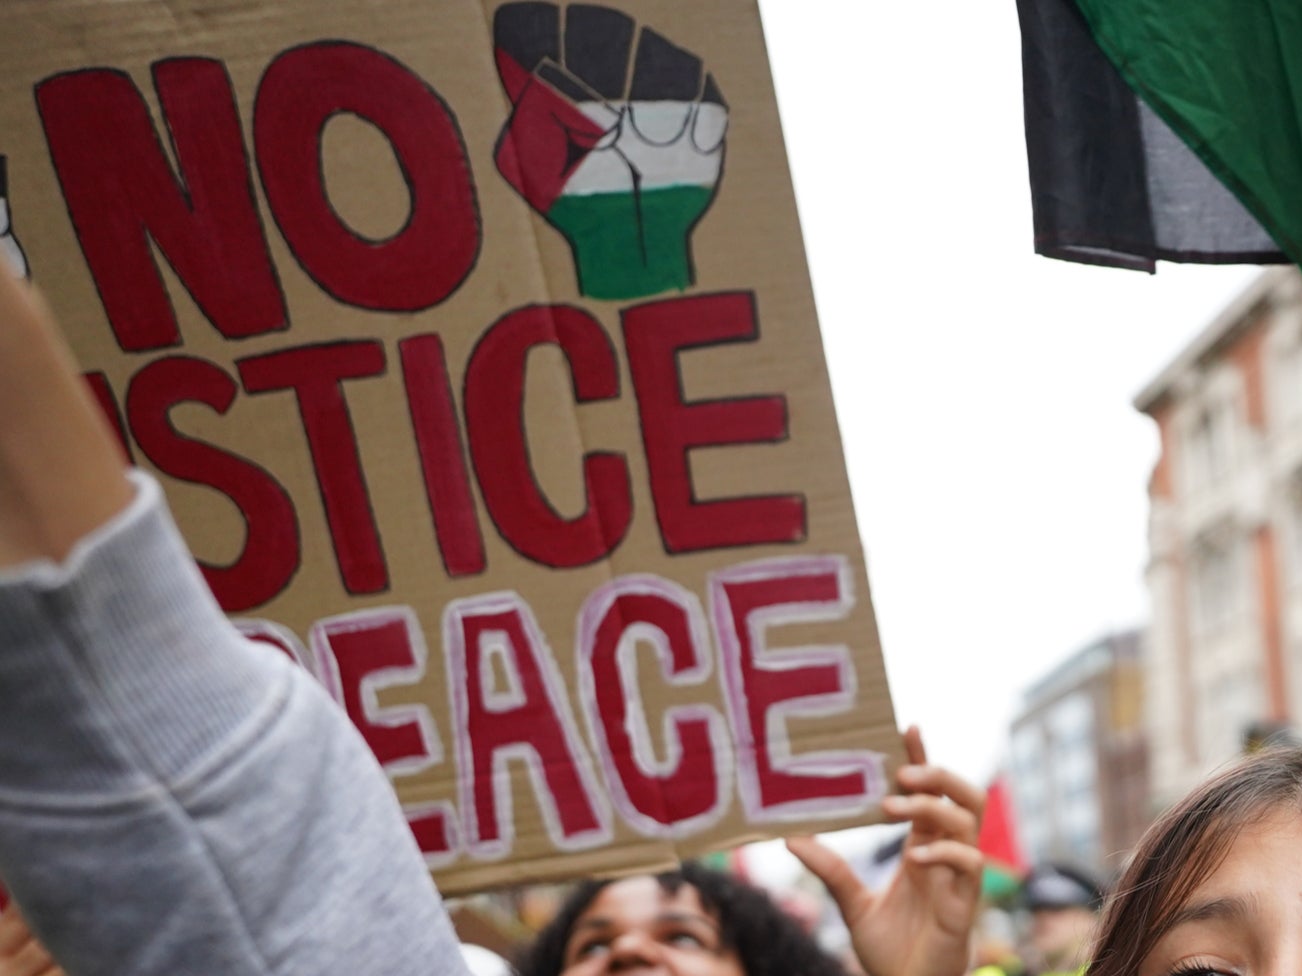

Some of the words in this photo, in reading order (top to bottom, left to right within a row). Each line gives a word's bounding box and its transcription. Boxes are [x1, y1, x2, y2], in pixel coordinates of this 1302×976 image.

[35, 40, 482, 351] NO
[82, 290, 806, 611] STICE
[236, 556, 889, 864] EACE
